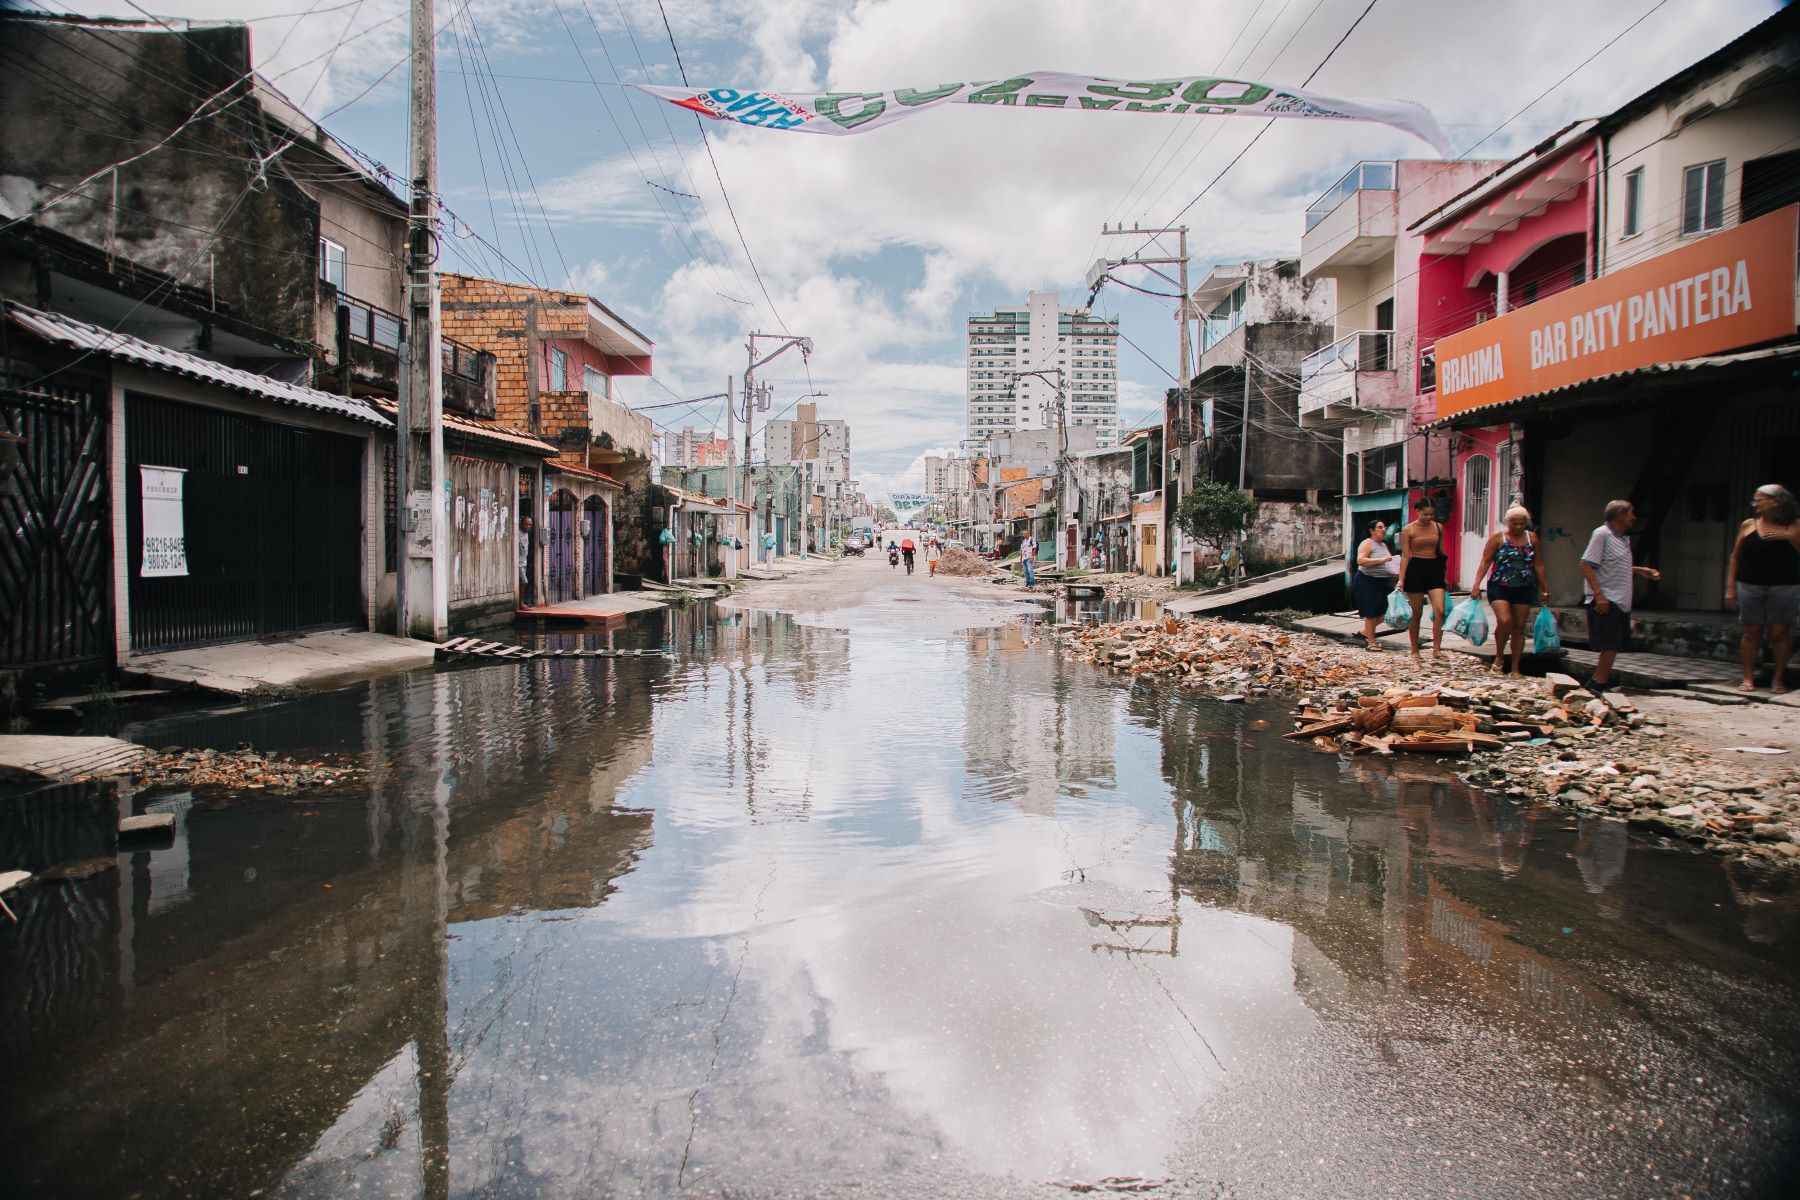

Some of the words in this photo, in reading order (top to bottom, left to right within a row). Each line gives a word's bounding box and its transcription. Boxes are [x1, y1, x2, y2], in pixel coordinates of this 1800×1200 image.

[1530, 321, 1567, 370] BAR
[1571, 301, 1624, 358] PATY
[1628, 260, 1752, 342] PANTERA
[1441, 343, 1504, 396] BRAHMA
